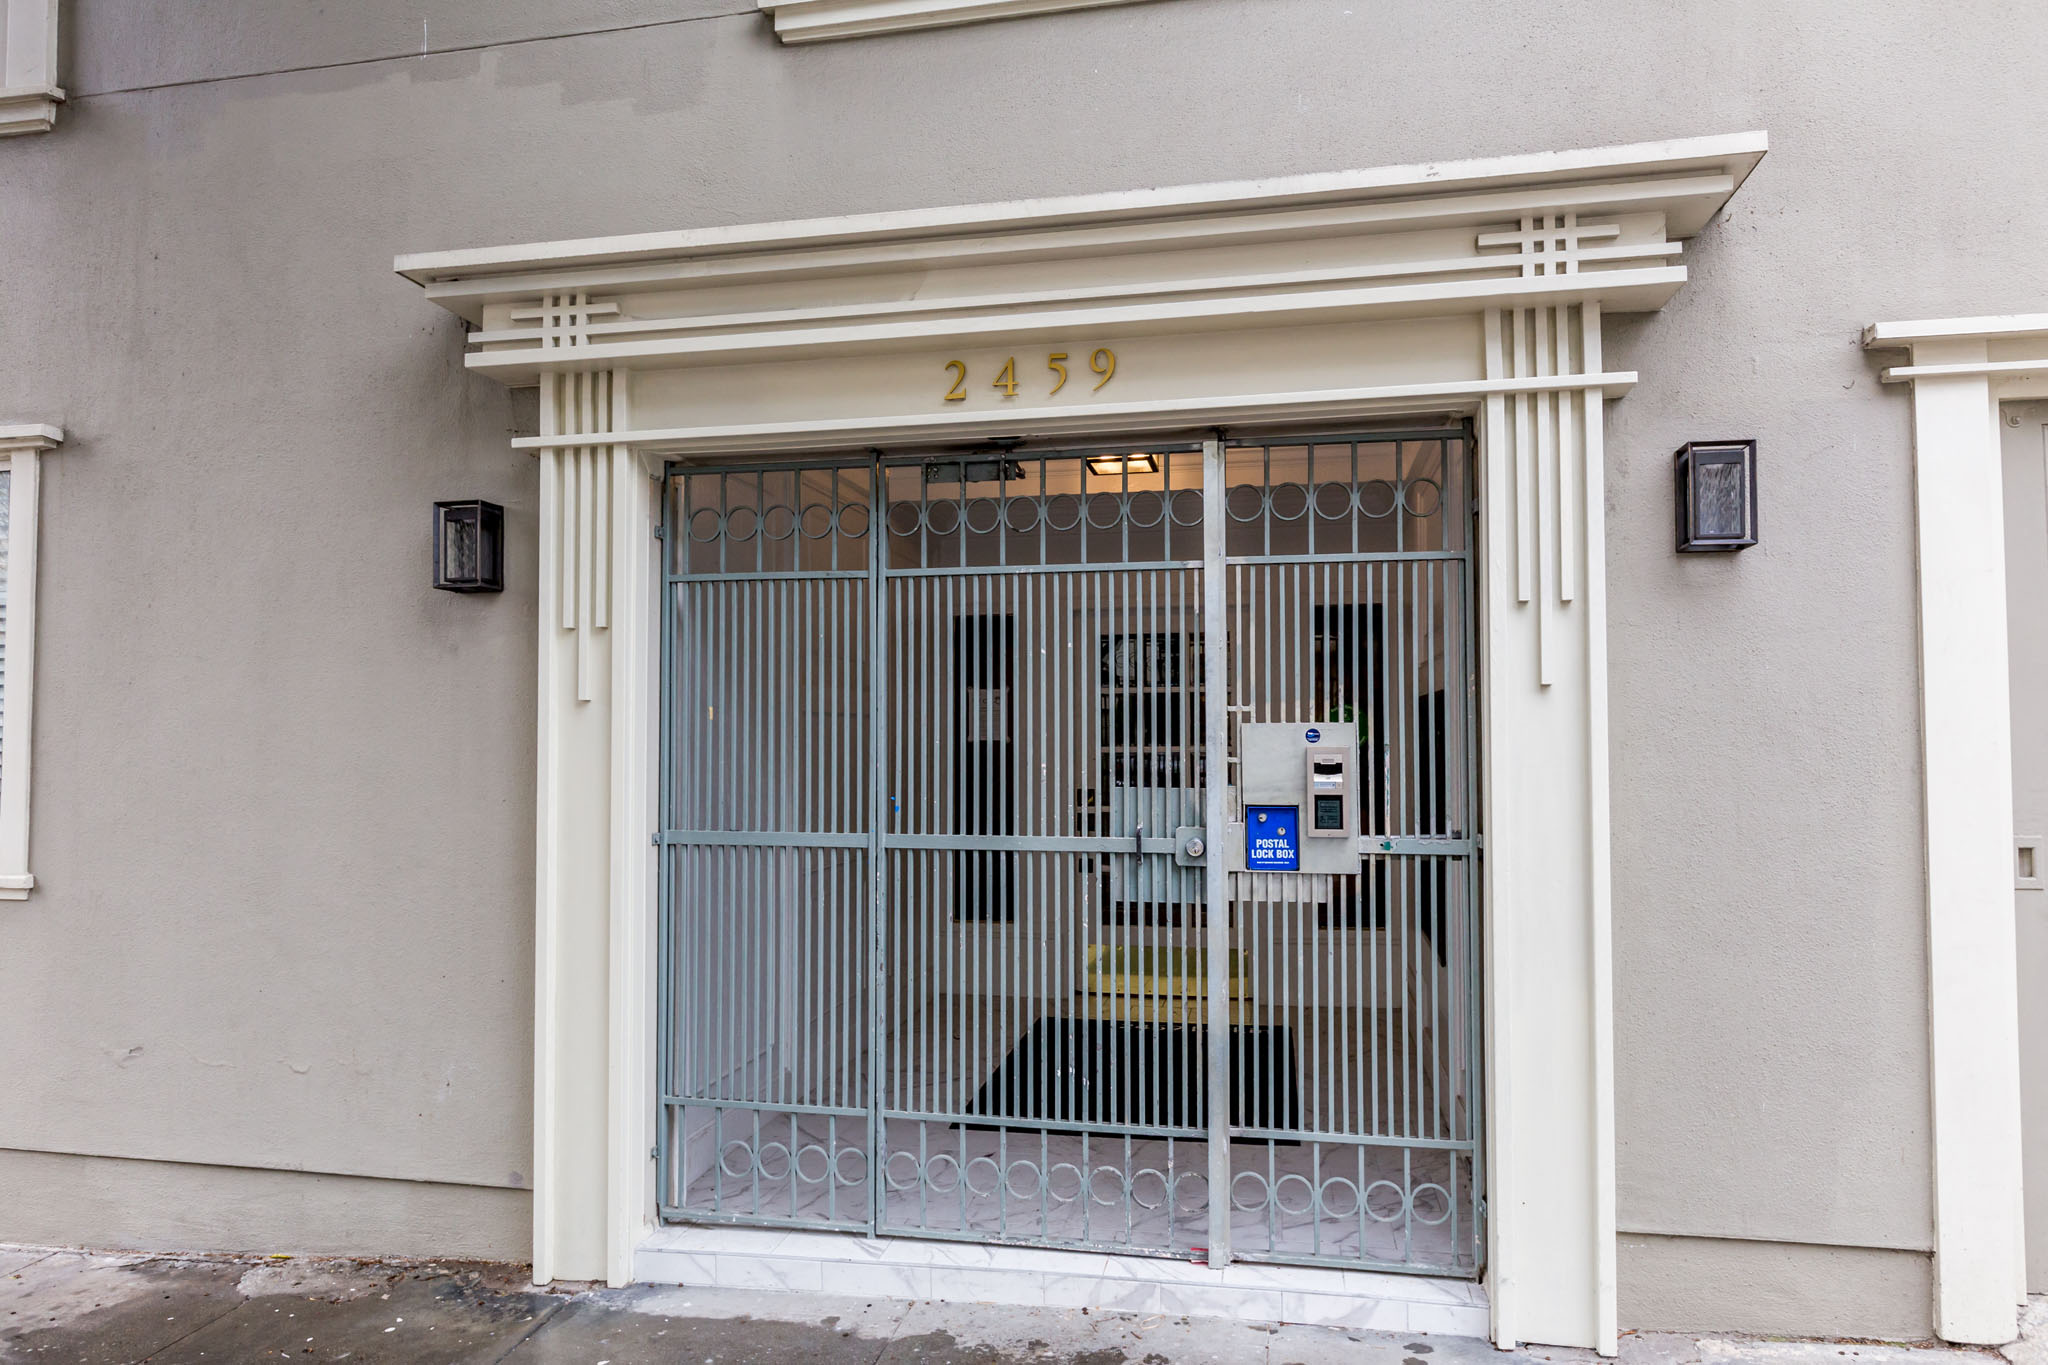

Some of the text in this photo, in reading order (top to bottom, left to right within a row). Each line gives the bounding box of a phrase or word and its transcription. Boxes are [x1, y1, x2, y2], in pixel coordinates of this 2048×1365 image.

[944, 347, 1116, 401] 2459
[1256, 839, 1290, 848] POSTAL
[1251, 849, 1295, 859] LOCK BOX
